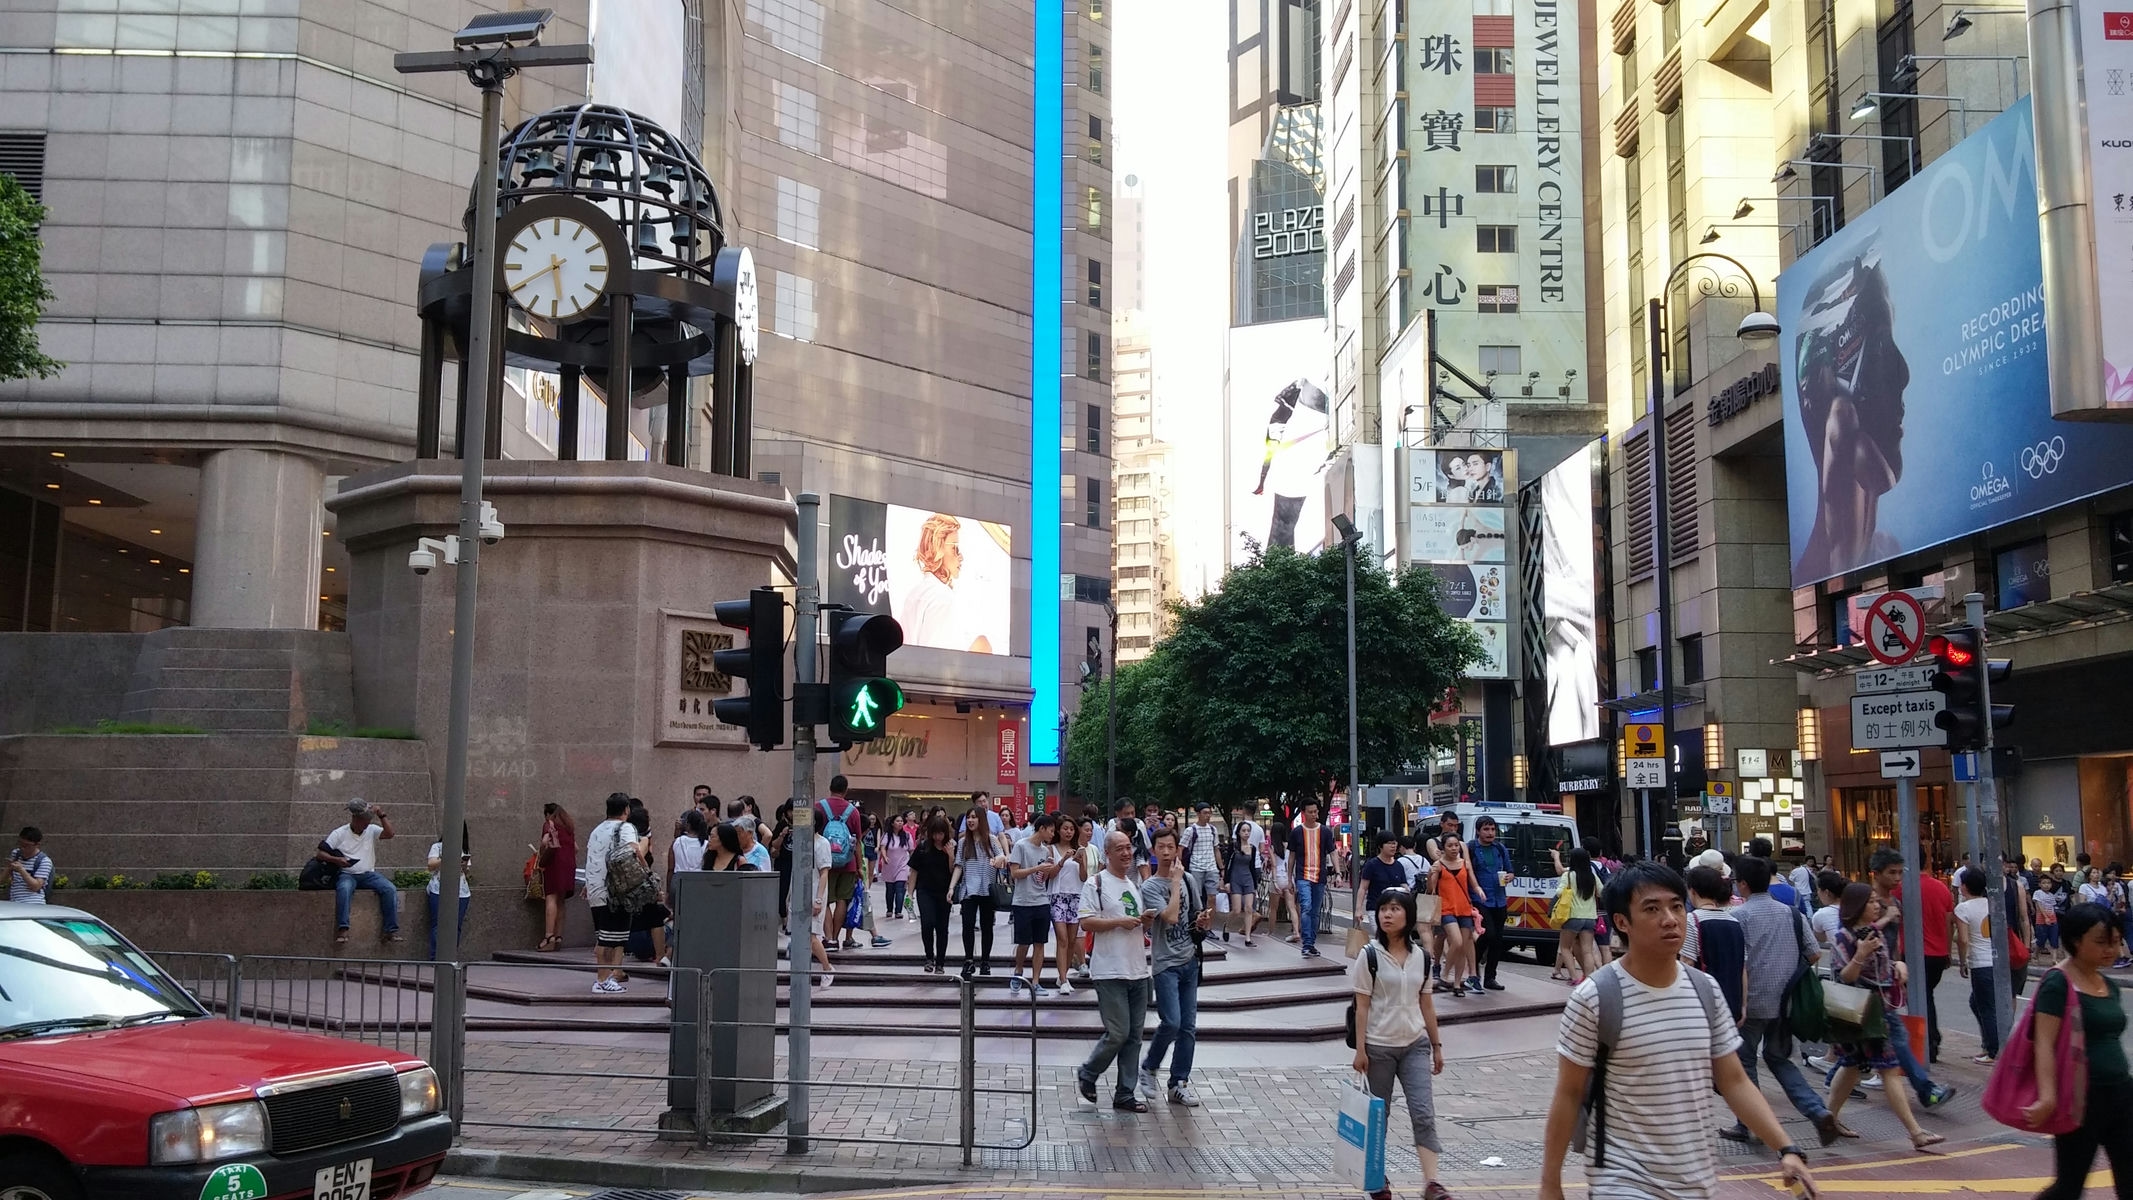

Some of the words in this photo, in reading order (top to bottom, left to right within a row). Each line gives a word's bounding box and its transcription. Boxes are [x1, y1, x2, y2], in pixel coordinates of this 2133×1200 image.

[1535, 0, 1561, 176] JEWELLERY
[1420, 34, 1467, 305] 珠寶中心
[1255, 205, 1325, 236] PLAZA
[1538, 181, 1564, 303] CENTRE
[1943, 331, 2006, 375] OLYMPIC
[1979, 356, 2008, 376] SINCE
[2014, 341, 2037, 360] 1932
[1412, 476, 1433, 492] 5/F
[1970, 476, 2010, 501] OMEGA
[836, 534, 889, 570] Shades
[853, 567, 867, 594] of
[1896, 679, 1921, 688] midnight
[1862, 701, 1903, 718] Except
[1905, 698, 1936, 714] taxis
[1866, 718, 1933, 740] 的士例外
[1632, 761, 1645, 769] 24
[1646, 761, 1660, 769] hrs
[1559, 778, 1600, 792] BURBERRY
[1634, 772, 1660, 785] 全日
[1512, 877, 1547, 889] OLICE
[219, 1165, 247, 1177] TAXI
[333, 1161, 357, 1188] EN
[227, 1174, 242, 1192] 5
